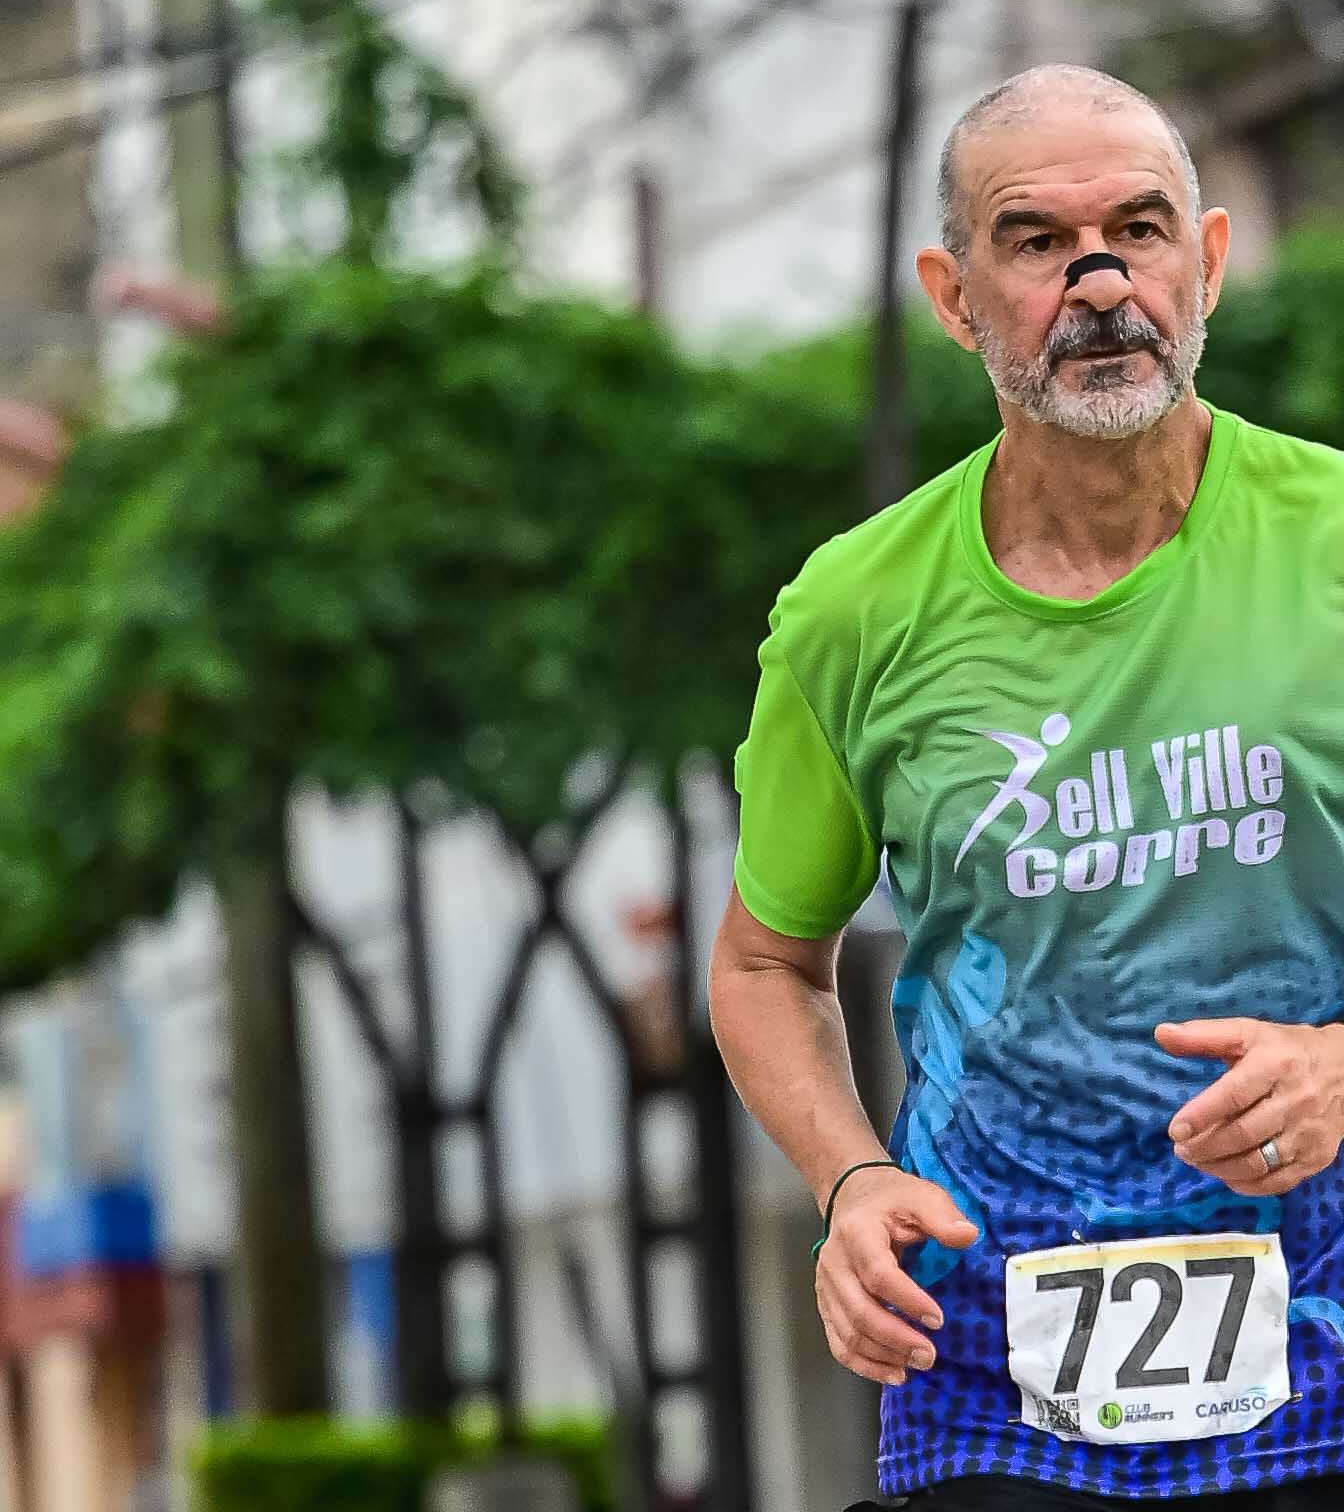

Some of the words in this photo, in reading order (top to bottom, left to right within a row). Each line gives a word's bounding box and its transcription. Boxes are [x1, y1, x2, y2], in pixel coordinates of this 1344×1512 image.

[1151, 724, 1284, 820] Ville
[1036, 1257, 1255, 1395] 727
[1195, 1396, 1265, 1418] CARUSO
